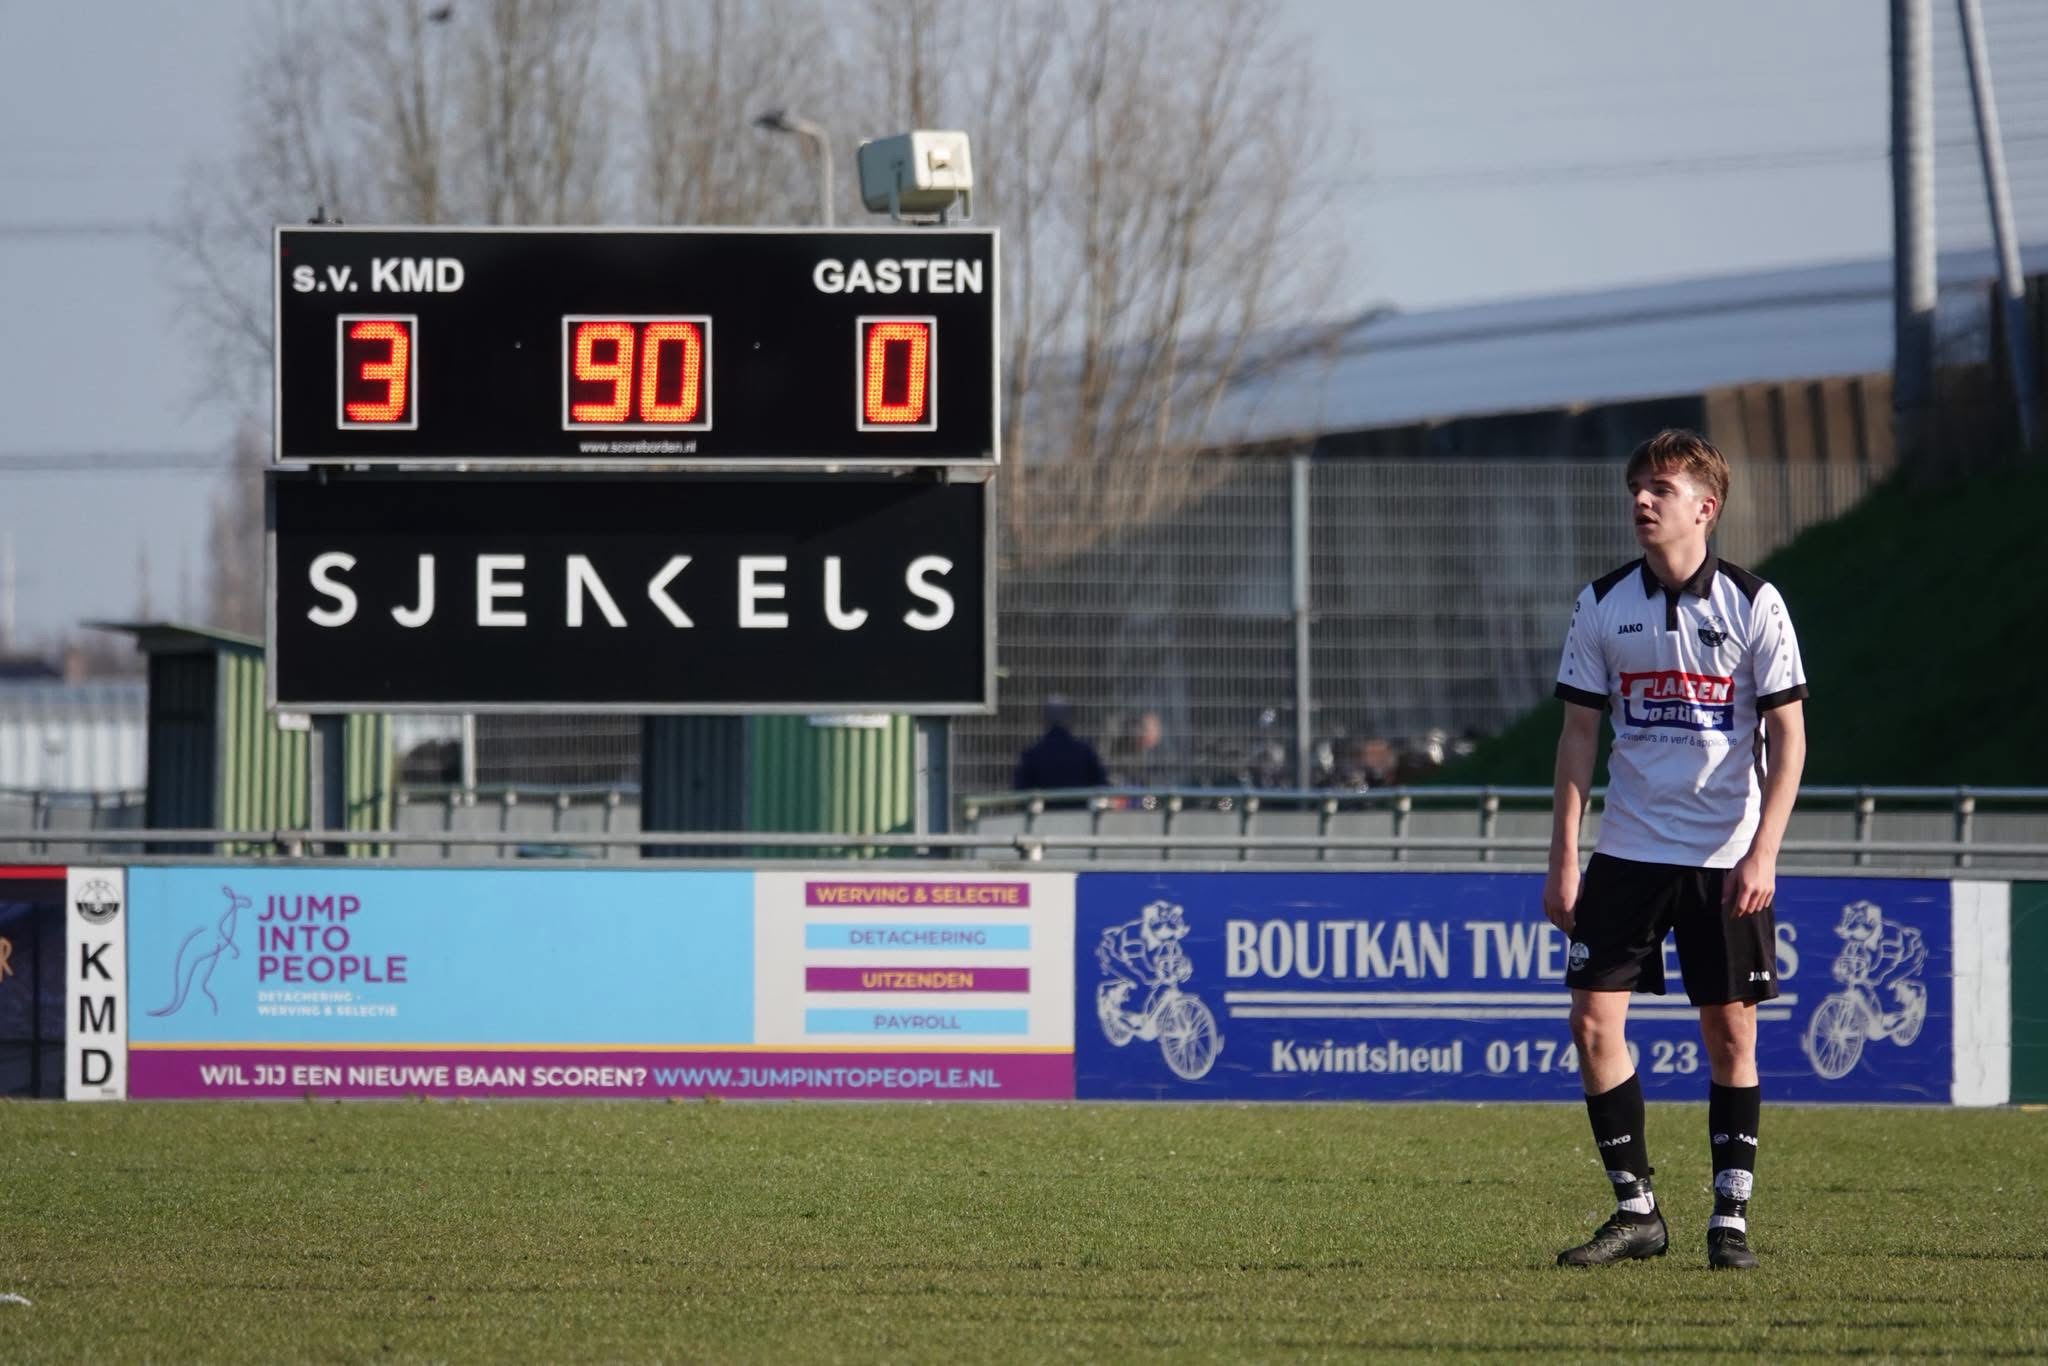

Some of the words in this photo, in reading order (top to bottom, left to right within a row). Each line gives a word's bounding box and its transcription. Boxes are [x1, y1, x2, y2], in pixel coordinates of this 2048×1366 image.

[293, 265, 358, 293] s.v.
[371, 257, 465, 293] KMD
[813, 258, 983, 293] GASTEN
[346, 321, 409, 422] 3
[571, 321, 701, 422] 90
[863, 321, 929, 422] 0
[1617, 623, 1643, 634] JAKO
[258, 895, 361, 921] JUMP
[815, 887, 909, 903] WERVING
[914, 887, 927, 904] &
[932, 887, 1019, 904] SELECTIE
[259, 926, 350, 952] INTO
[849, 930, 987, 945] DETACHERING
[1226, 920, 1449, 979] BOUTKAN
[259, 955, 408, 983] PEOPLE
[862, 972, 974, 989] UITZENDEN
[258, 991, 353, 1003] DETACHERING
[79, 942, 116, 1086] KMD
[258, 1005, 321, 1017] WERVING
[336, 1005, 398, 1017] SELECTIE
[874, 1015, 961, 1030] PAYROLL
[1272, 1040, 1463, 1073] Kwintsheul
[1652, 1040, 1699, 1073] 23
[201, 1066, 249, 1086] WIL
[253, 1066, 286, 1086] JIJ
[293, 1067, 341, 1086] EEN
[349, 1067, 449, 1087] NIEUWE
[456, 1067, 526, 1087] BAAN
[532, 1067, 647, 1087] SCOREN?
[653, 1068, 1002, 1088] WWW.JUMPINTOPEOPLE.NL
